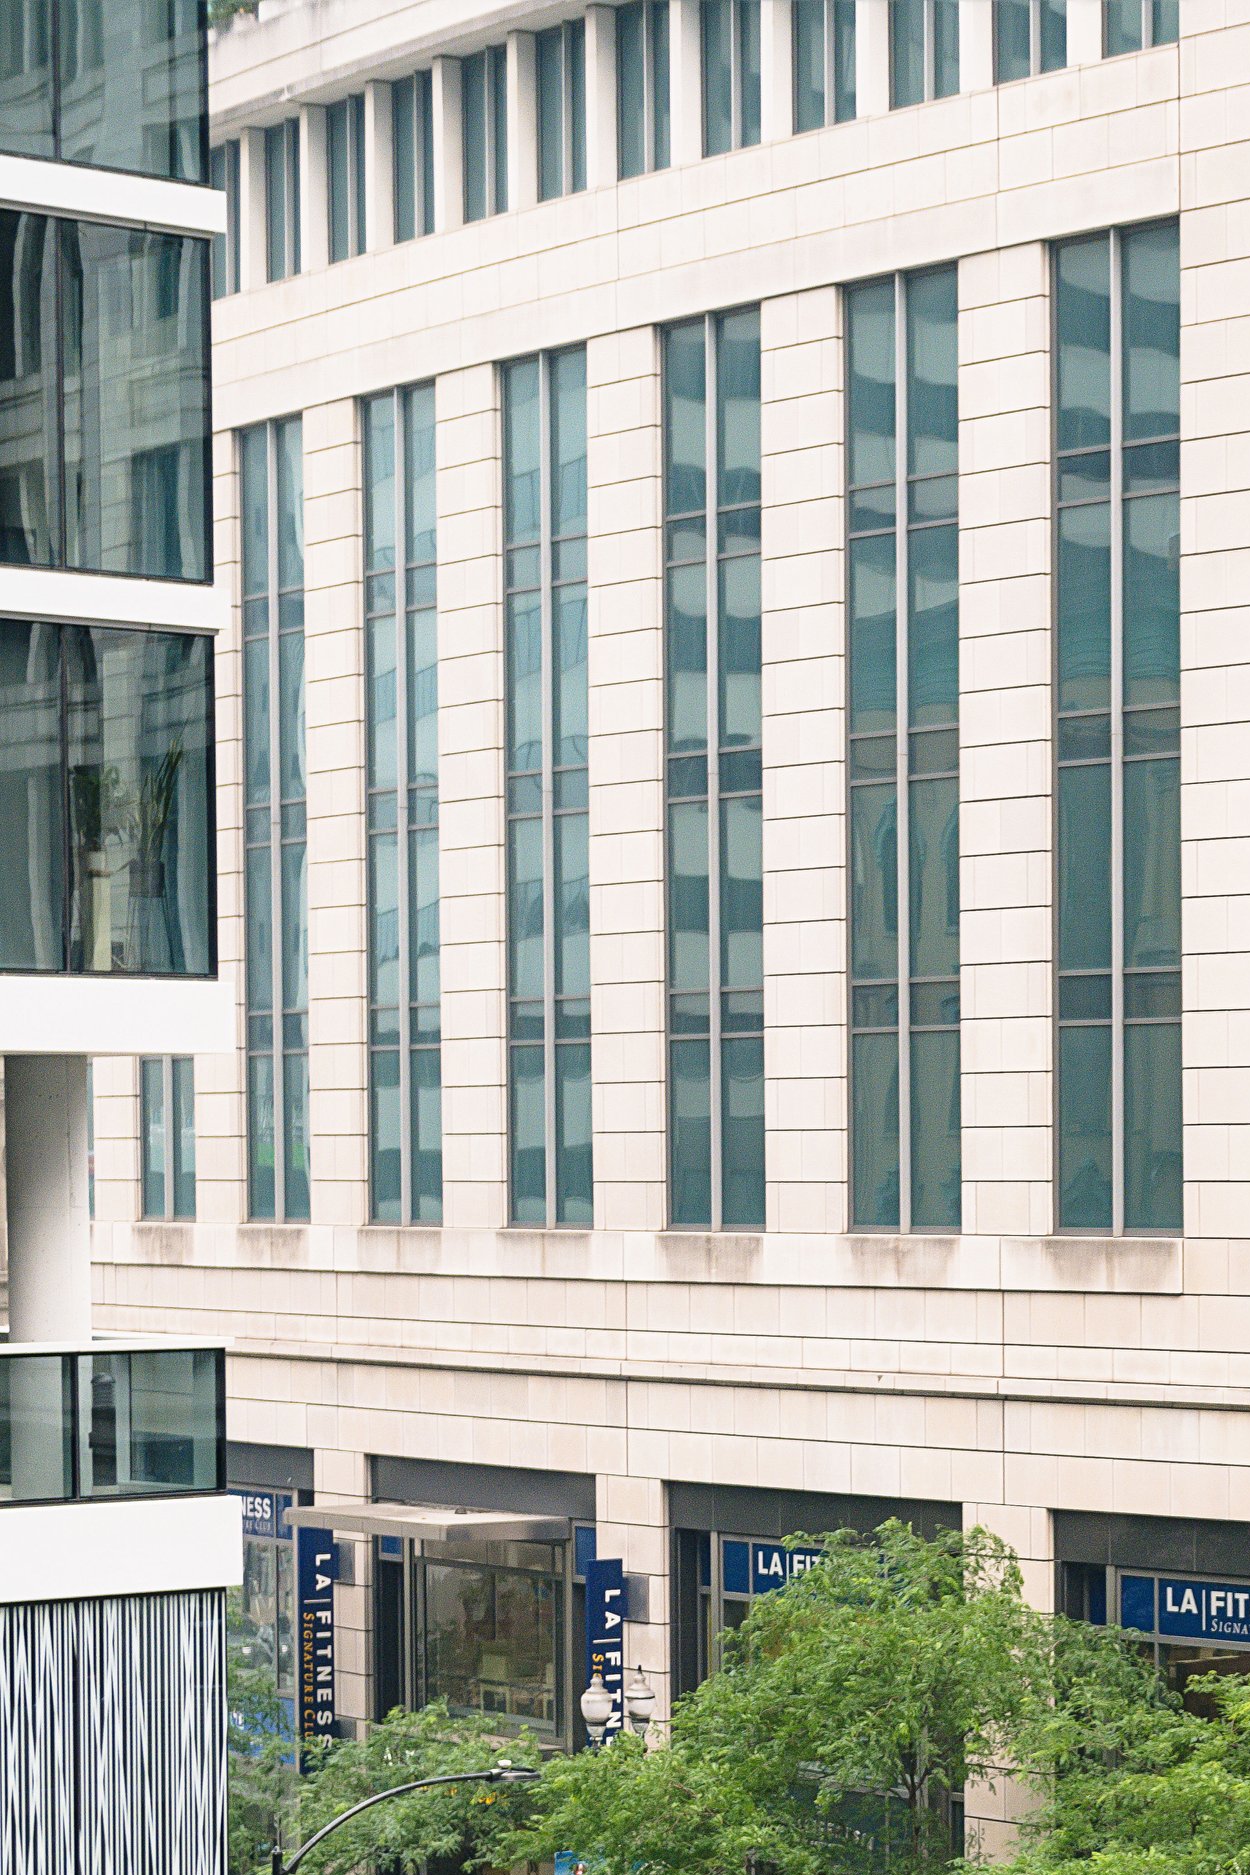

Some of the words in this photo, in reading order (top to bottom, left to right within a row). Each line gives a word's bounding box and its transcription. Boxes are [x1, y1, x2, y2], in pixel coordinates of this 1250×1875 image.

[315, 1553, 332, 1592] LA
[758, 1551, 783, 1576] LA
[605, 1589, 621, 1629] LA
[1166, 1586, 1198, 1614] LA
[303, 1612, 315, 1703] SIGNATURE
[316, 1610, 333, 1749] FITNESS
[304, 1709, 316, 1741] CLU
